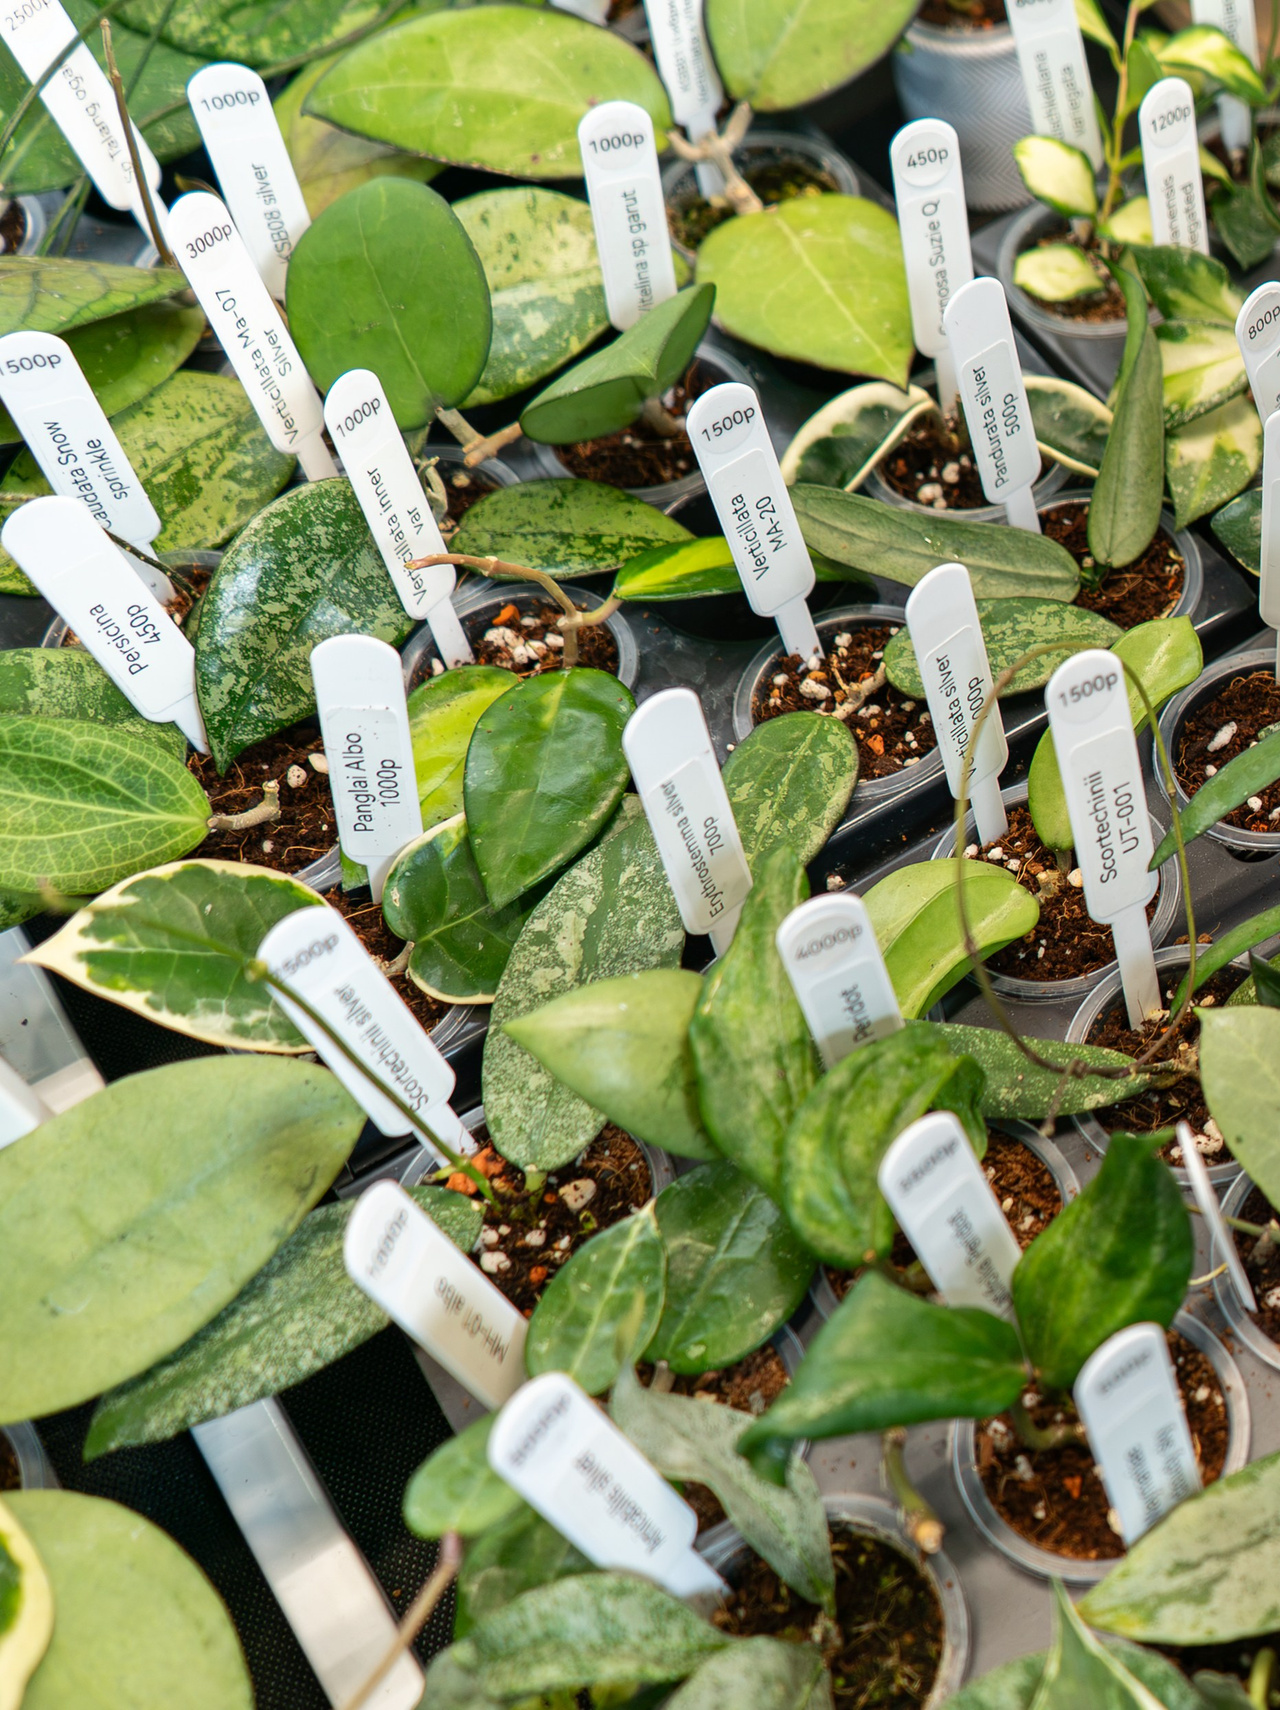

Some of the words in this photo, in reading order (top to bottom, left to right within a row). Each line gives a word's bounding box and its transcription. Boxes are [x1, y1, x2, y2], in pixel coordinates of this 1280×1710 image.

[5, 0, 51, 31] 2500
[200, 89, 260, 113] 1000p
[1151, 104, 1192, 134] 1200p
[588, 132, 645, 154] 1000p
[906, 146, 949, 169] 450p
[251, 163, 278, 206] silver
[621, 188, 647, 235] garut
[922, 199, 941, 217] Q
[185, 221, 233, 260] 3000p
[633, 238, 650, 258] sp
[925, 220, 945, 267] Suzie
[215, 288, 257, 349] Ma-07
[263, 327, 292, 377] Silver
[250, 347, 299, 445] Verticillata
[973, 366, 994, 410] silver
[335, 396, 382, 439] 1000p
[700, 406, 756, 442] 1500p
[1001, 393, 1021, 437] 500p
[44, 421, 78, 467] Snow
[981, 410, 1009, 489] Pandurata
[86, 438, 128, 500] sprinkle
[367, 468, 393, 515] inner
[406, 507, 425, 536] var
[731, 493, 771, 581] Verticillata
[755, 495, 788, 553] MA-20
[387, 516, 428, 606] Vertcillata
[89, 603, 149, 676] Persicina
[126, 603, 161, 645] 450p
[937, 654, 957, 697] silver
[1057, 670, 1119, 709] 1500p
[967, 676, 988, 727] 000p
[342, 732, 364, 771] Albo
[946, 697, 977, 782] Vticillata
[346, 775, 377, 832] Panglai
[376, 758, 403, 808] 1000p
[661, 780, 687, 817] silver
[702, 815, 725, 858] 700p
[1083, 769, 1118, 886] Scortechinii
[1111, 780, 1140, 855] UT-001
[676, 816, 725, 919] Erythrostemma
[795, 924, 863, 961] 4000p
[332, 981, 373, 1027] silver
[839, 983, 878, 1044] Peridot
[359, 1025, 429, 1113] Scortechinii
